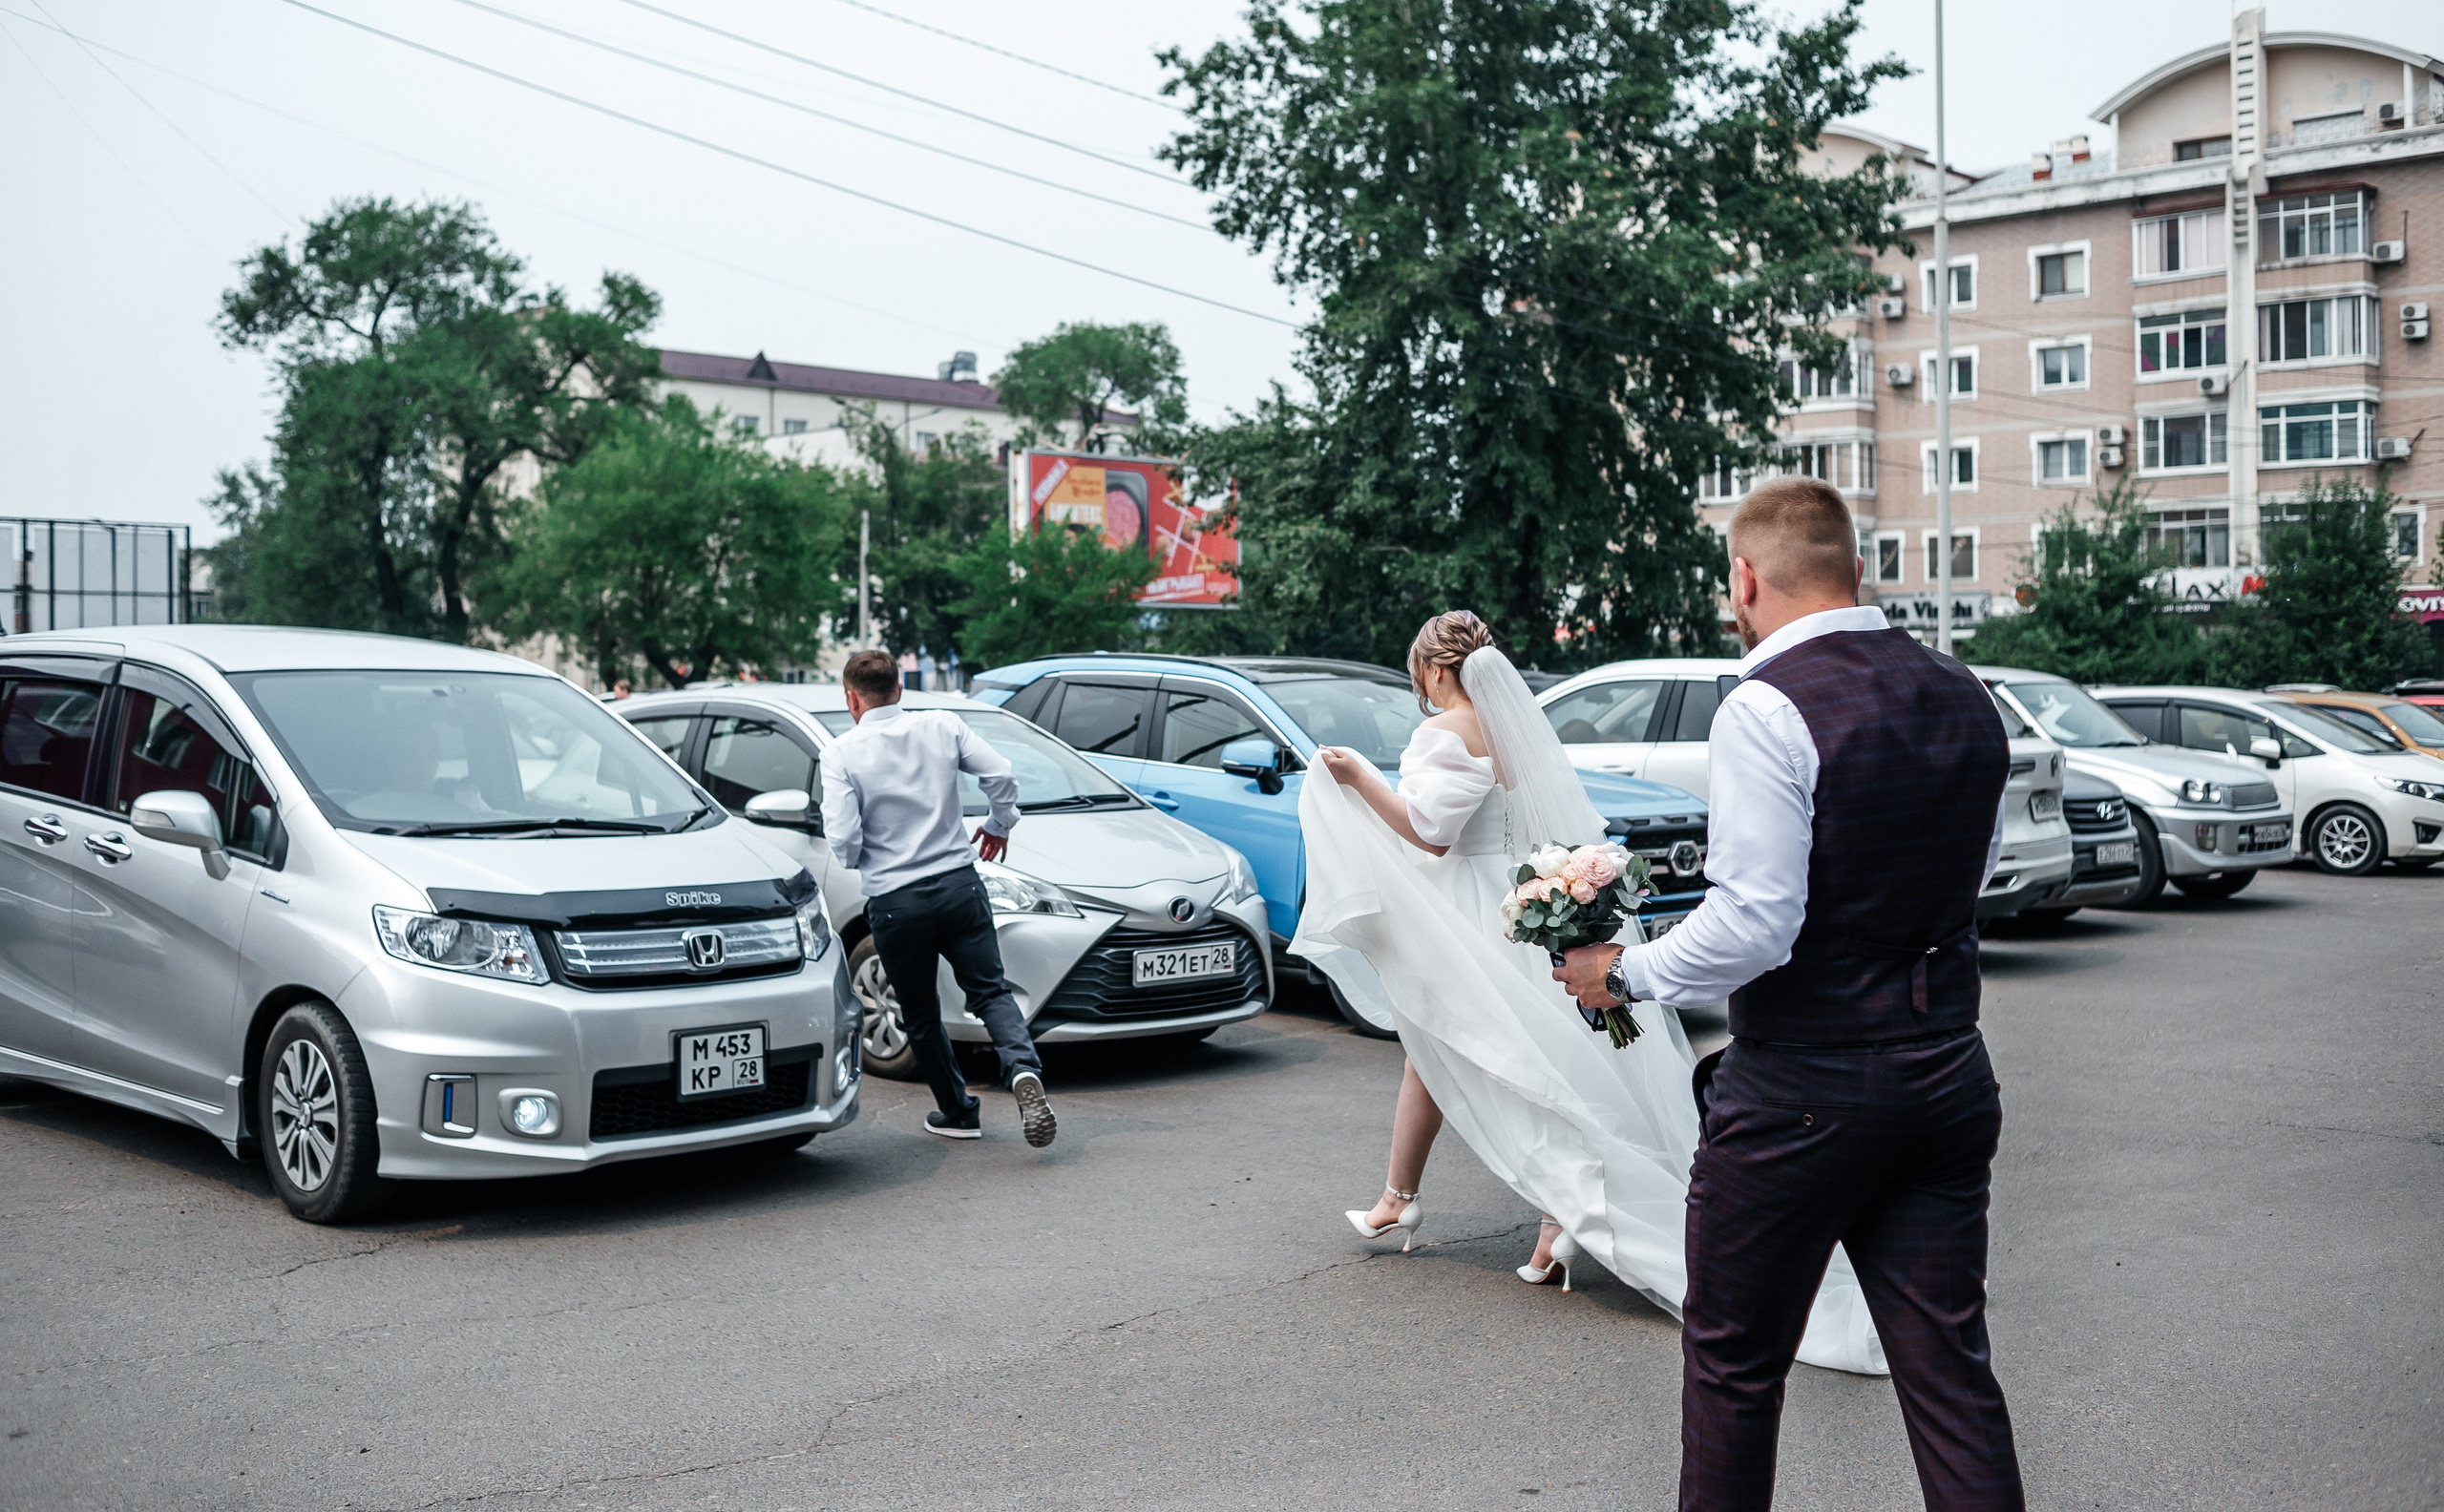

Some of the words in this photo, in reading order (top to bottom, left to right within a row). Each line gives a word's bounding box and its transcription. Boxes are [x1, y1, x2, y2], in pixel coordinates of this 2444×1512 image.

[665, 891, 722, 907] Spike
[1143, 953, 1210, 977] М321ЕТ
[1213, 947, 1229, 964] 28
[693, 1038, 708, 1061] М
[715, 1033, 751, 1058] 453
[691, 1065, 722, 1090] КР
[739, 1060, 758, 1079] 28
